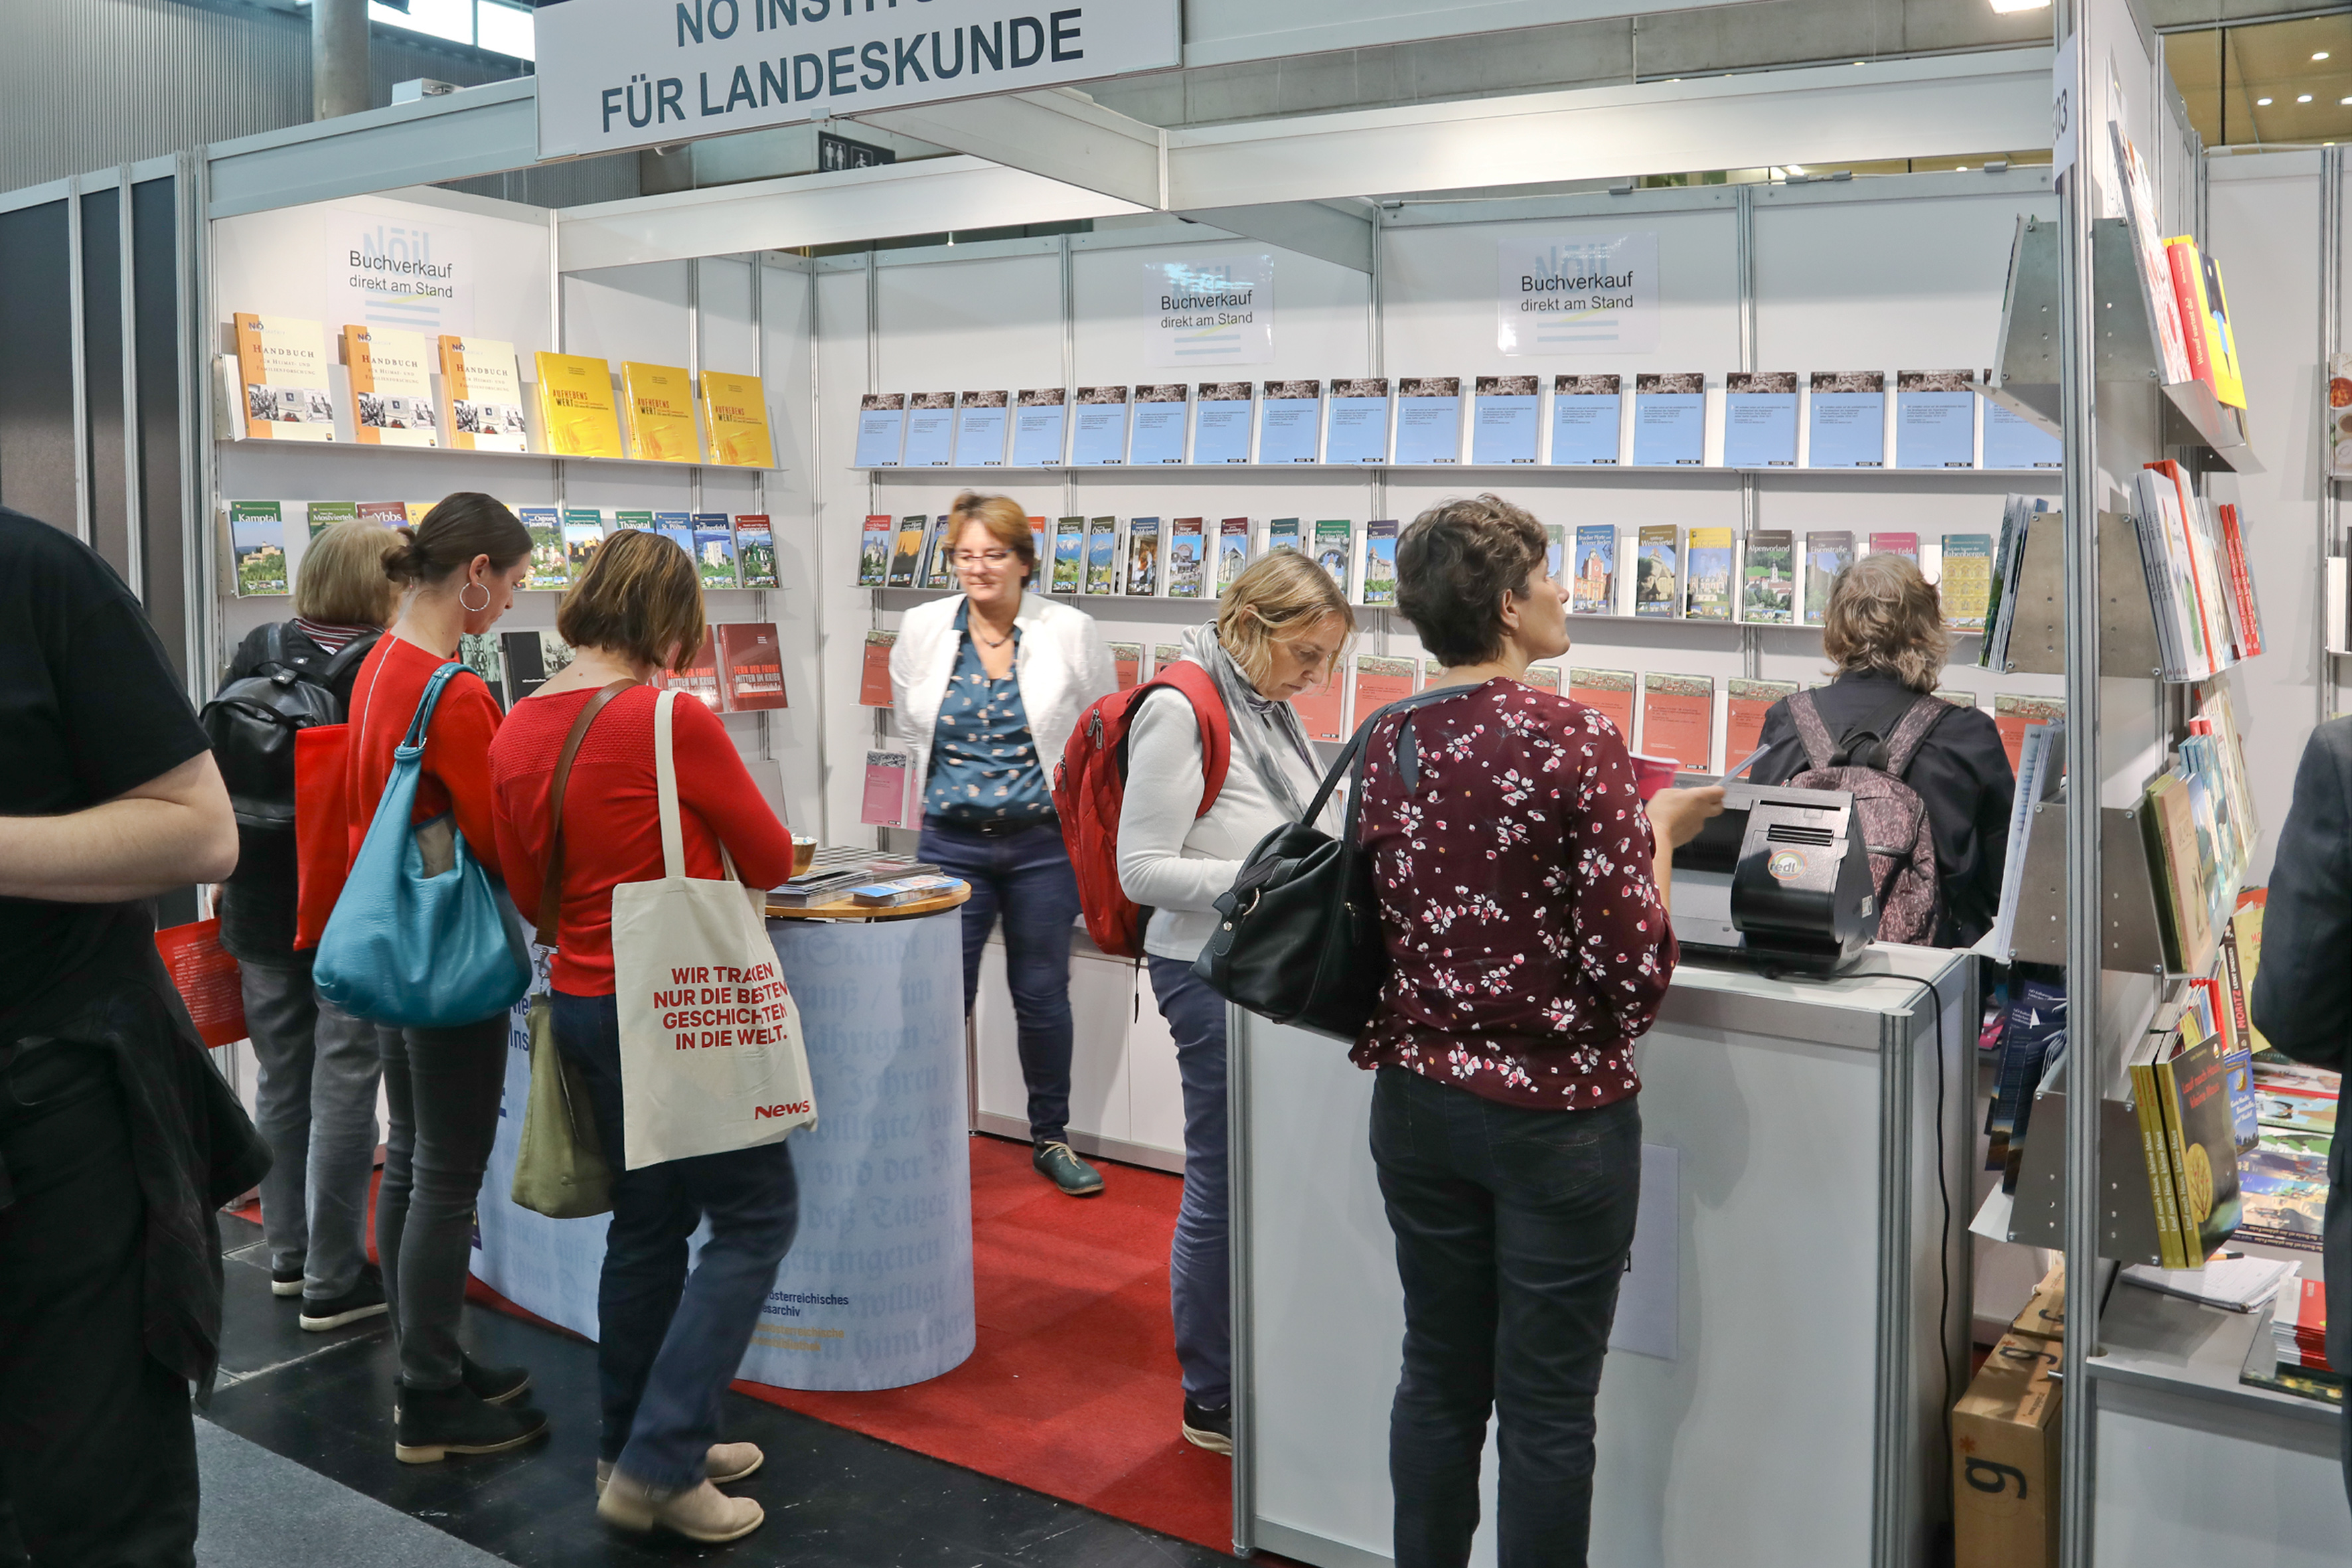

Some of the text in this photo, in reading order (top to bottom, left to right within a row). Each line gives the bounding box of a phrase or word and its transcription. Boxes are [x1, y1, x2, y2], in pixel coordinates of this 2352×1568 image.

[602, 8, 1083, 133] FÜR LANDESKUNDE
[2053, 88, 2067, 145] 03
[350, 250, 452, 278] Buchverkauf
[349, 275, 453, 298] direkt am Stand
[1522, 271, 1633, 291] Buchverkauf
[1161, 290, 1253, 310] Buchverkauf
[1521, 295, 1633, 311] direkt am Stand
[1160, 311, 1253, 328] direkt am Stand
[2183, 296, 2205, 365] Worauf wartest du?
[252, 344, 314, 358] HANDBUCH
[362, 354, 418, 368] HANDBUCH
[457, 364, 508, 376] HANDBUCH
[553, 390, 588, 400] AUFHEBENS
[556, 398, 574, 407] WERT
[638, 398, 669, 408] AUFHEBENS
[640, 406, 656, 415] WERT
[716, 406, 744, 415] AUFHEBENS
[718, 414, 732, 422] WERT
[238, 512, 277, 523] Kamptal
[374, 512, 402, 522] Ybbs
[1748, 544, 1790, 553] Alpenvorland
[667, 676, 716, 687] MITTEN IM KRIEG
[735, 672, 781, 683] MITTEN IM KRIEG
[1770, 862, 1796, 874] redl
[671, 967, 709, 984] WIR
[653, 980, 789, 1008] NUR DIE BESTEN
[663, 1002, 787, 1030] GESCHICHTEN
[676, 1025, 787, 1050] IN DIE WELT.
[755, 1101, 810, 1119] News
[2143, 1131, 2153, 1151] Maus
[2154, 1131, 2164, 1150] Maus
[2169, 1129, 2179, 1150] Maus
[2146, 1151, 2157, 1174] kleine
[2158, 1151, 2168, 1174] kleine
[2173, 1150, 2183, 1172] kleine
[2154, 1196, 2164, 1215] nach
[2165, 1196, 2175, 1215] nach
[2180, 1195, 2190, 1214] nach
[2157, 1215, 2167, 1231] Lauf
[2169, 1215, 2178, 1231] Lauf
[2183, 1214, 2193, 1230] Lauf
[769, 1290, 849, 1306] österreichisches
[763, 1304, 801, 1317] esarchiv
